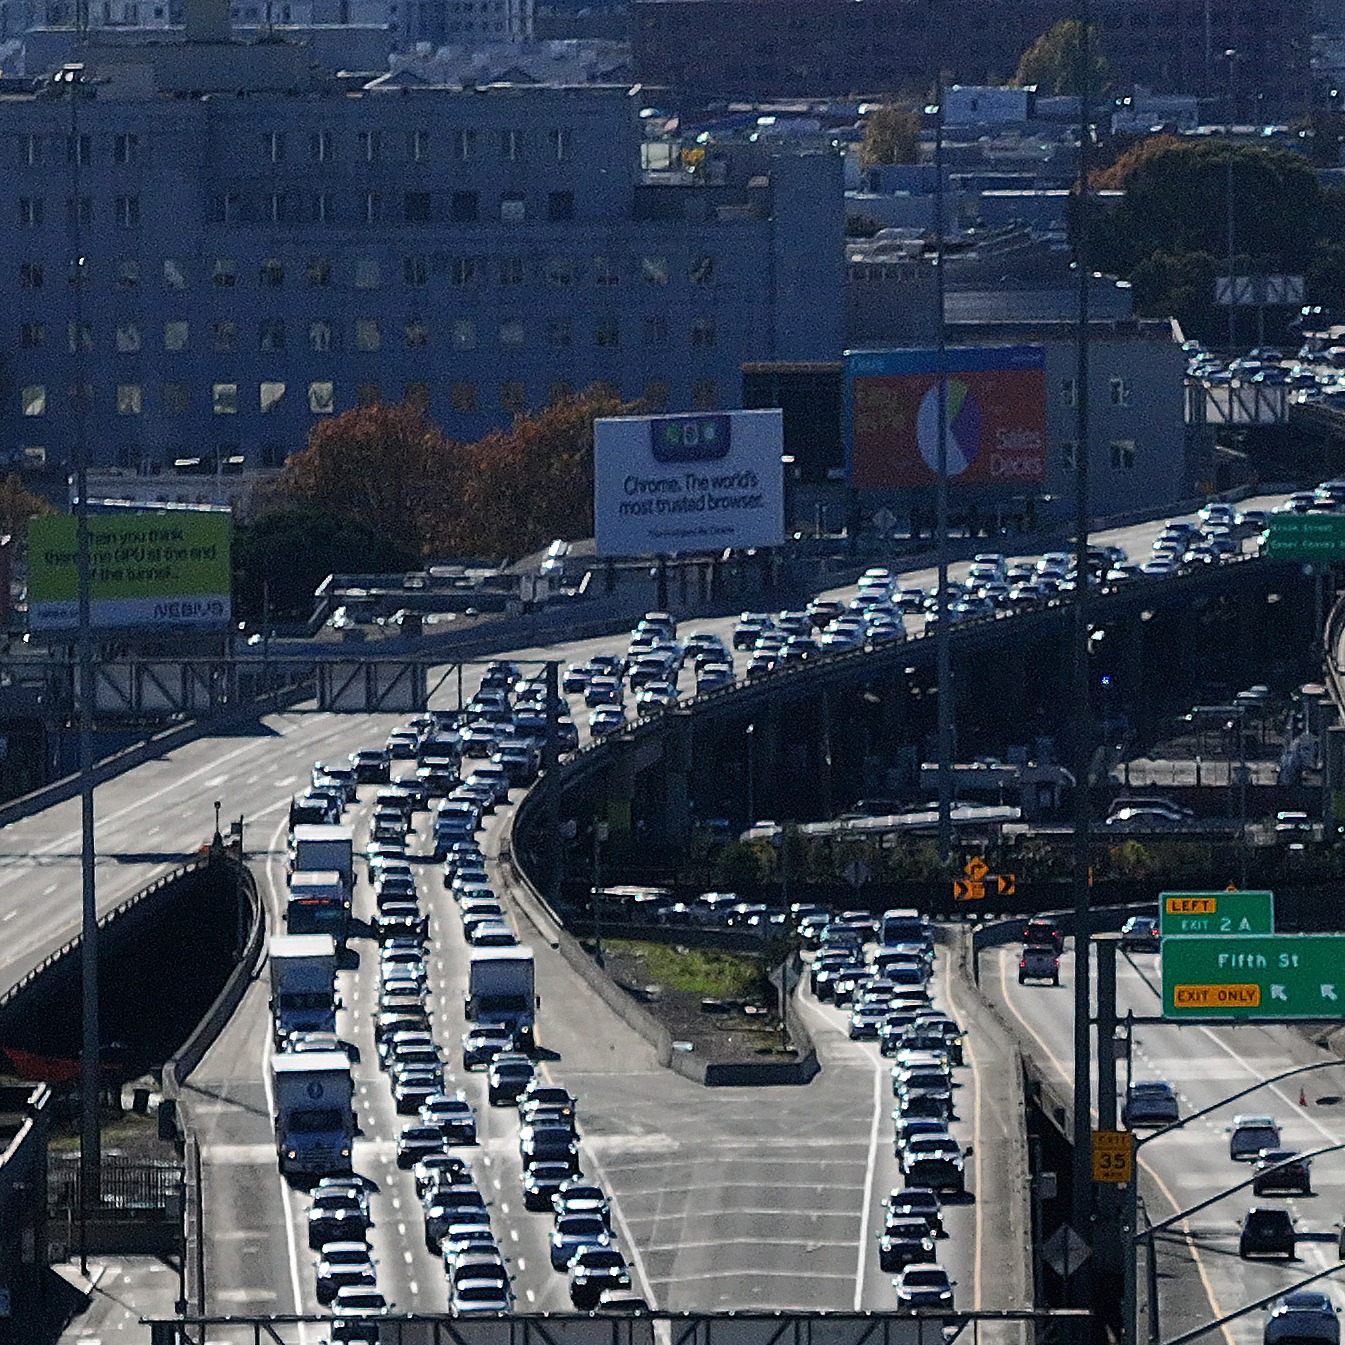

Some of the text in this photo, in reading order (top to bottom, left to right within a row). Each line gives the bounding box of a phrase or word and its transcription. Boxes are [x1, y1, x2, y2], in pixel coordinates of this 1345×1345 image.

[684, 472, 709, 491] The
[712, 468, 759, 489] world's
[619, 499, 654, 516] most
[655, 495, 706, 514] trusted
[87, 530, 116, 545] hen
[120, 532, 146, 545] you
[114, 548, 145, 563] GPU
[1171, 899, 1210, 913] LEFT
[1181, 918, 1209, 932] EXIT
[1217, 953, 1300, 969] Fifth St
[1177, 989, 1257, 1002] EXIT ONLY
[1099, 1153, 1126, 1169] 35
